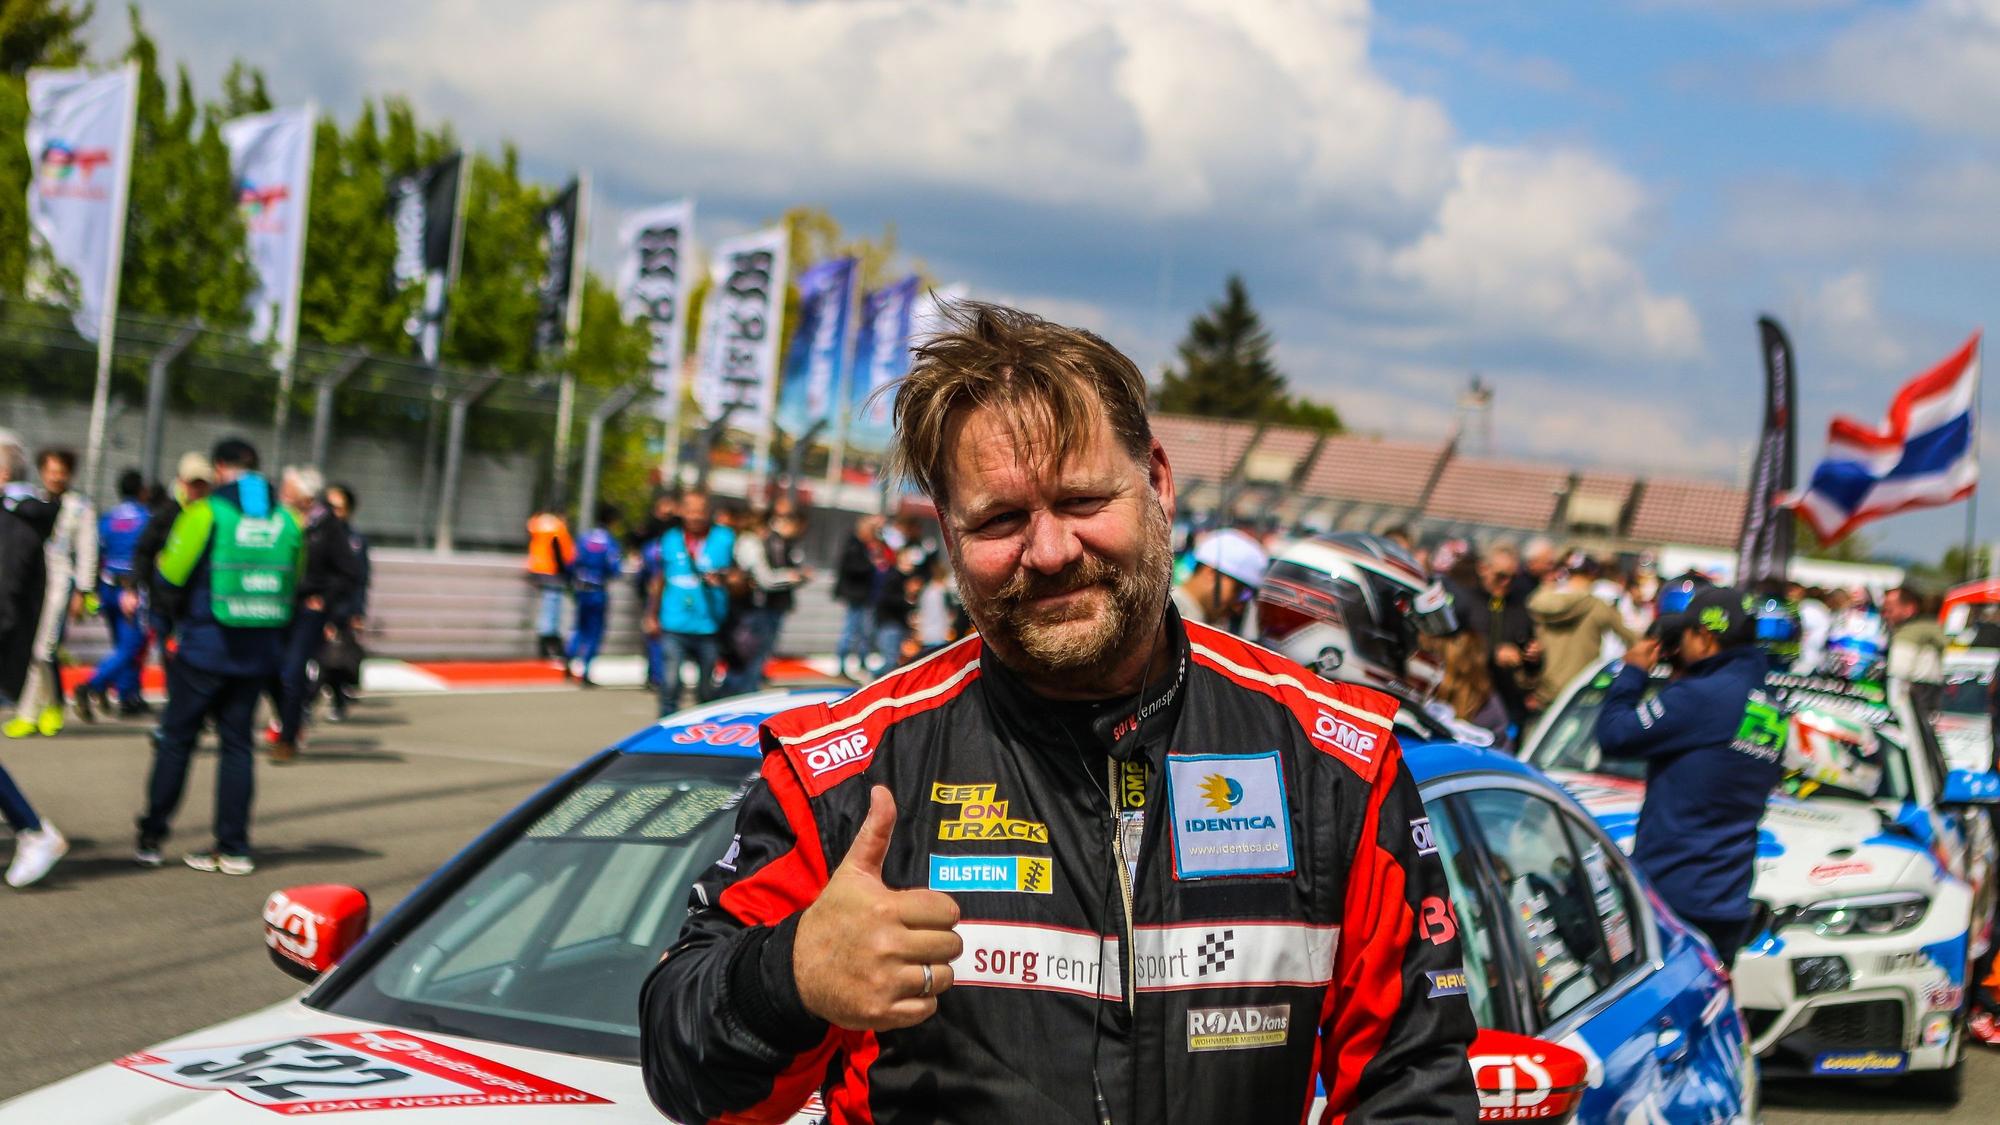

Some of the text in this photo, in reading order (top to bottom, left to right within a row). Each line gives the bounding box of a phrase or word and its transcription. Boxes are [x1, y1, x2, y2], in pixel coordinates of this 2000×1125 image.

[672, 723, 760, 747] SO
[1315, 715, 1375, 755] OMP
[807, 734, 868, 770] OMP
[935, 786, 992, 801] GET
[1127, 760, 1145, 808] OMP
[964, 804, 1005, 819] ON
[944, 822, 1048, 840] TRACK
[1185, 815, 1276, 833] IDENTICA
[1188, 841, 1280, 856] www.identica.de
[939, 865, 1008, 882] BILSTEIN
[974, 948, 1039, 984] sorg
[1137, 947, 1189, 986] sport
[175, 1038, 413, 1101] 522
[287, 1094, 587, 1114] ADAC NORDRHEIN
